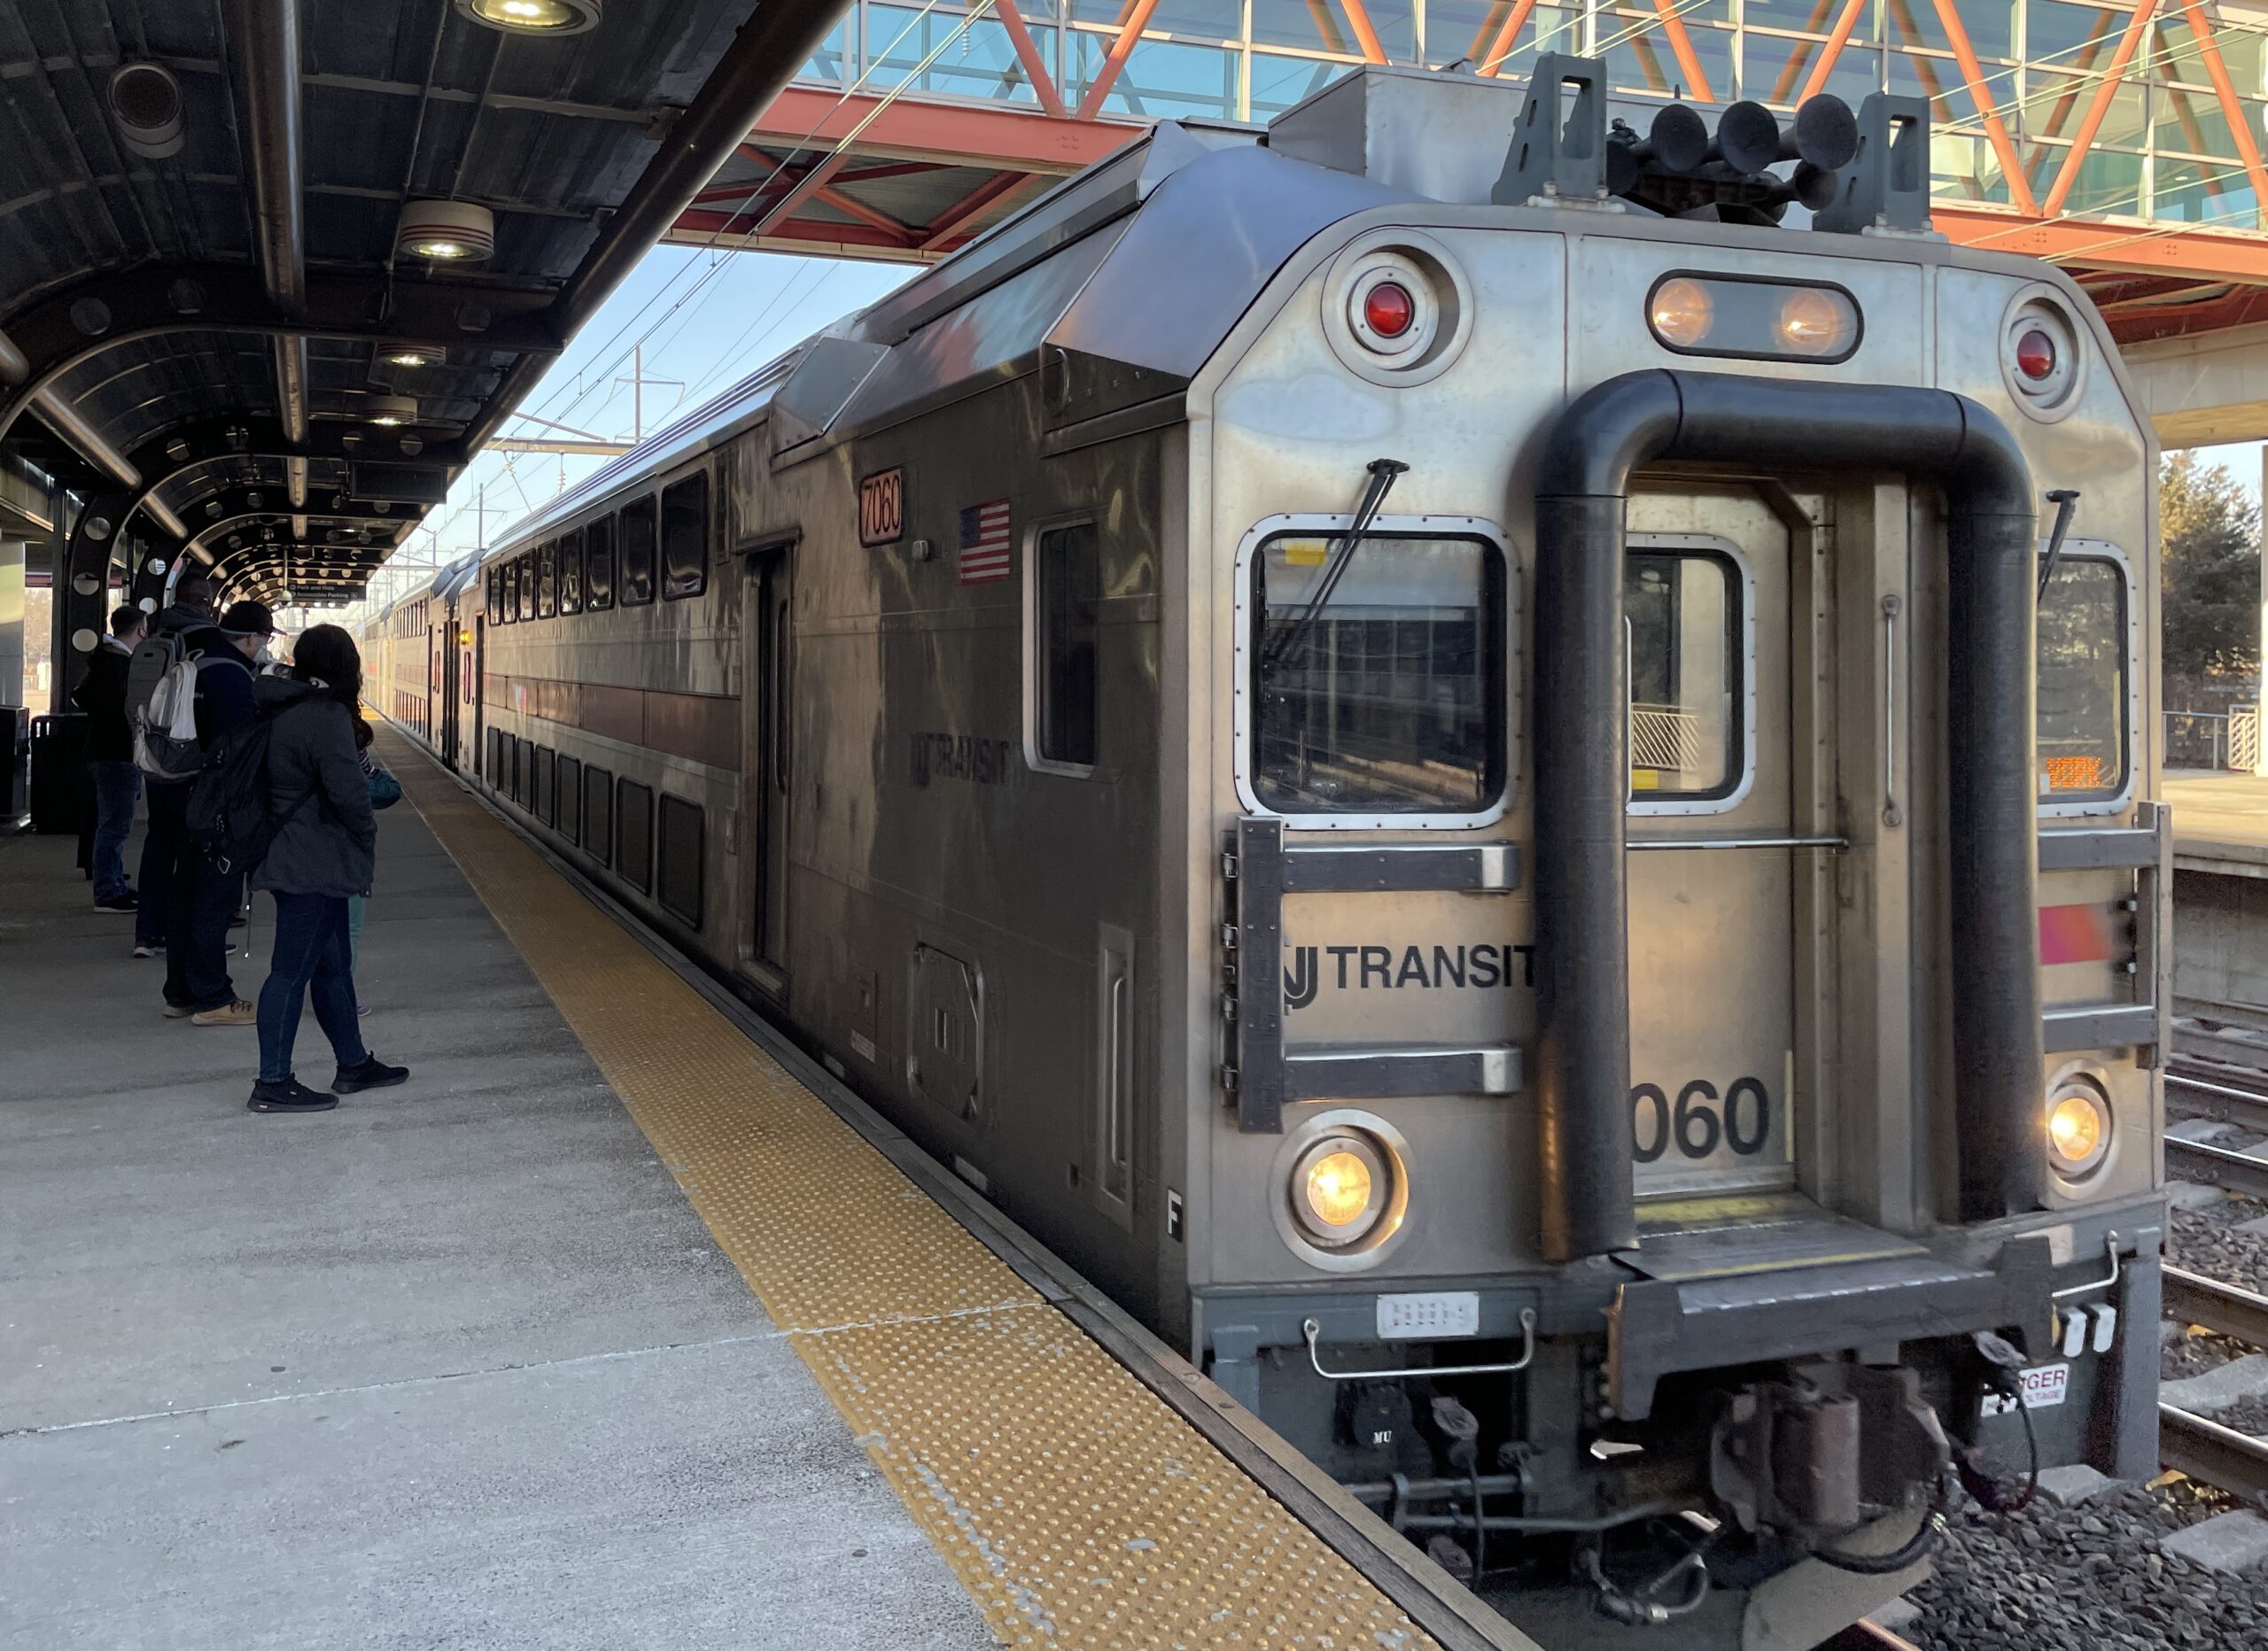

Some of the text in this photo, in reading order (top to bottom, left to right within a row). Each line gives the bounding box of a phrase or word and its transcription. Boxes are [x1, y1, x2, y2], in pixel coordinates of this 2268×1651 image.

[863, 475, 900, 536] 7060
[1326, 944, 1536, 988] TRANSIT
[1630, 1076, 1769, 1163] 060
[1168, 1190, 1182, 1235] F
[2024, 1369, 2065, 1390] GER
[1373, 1430, 1392, 1444] MU
